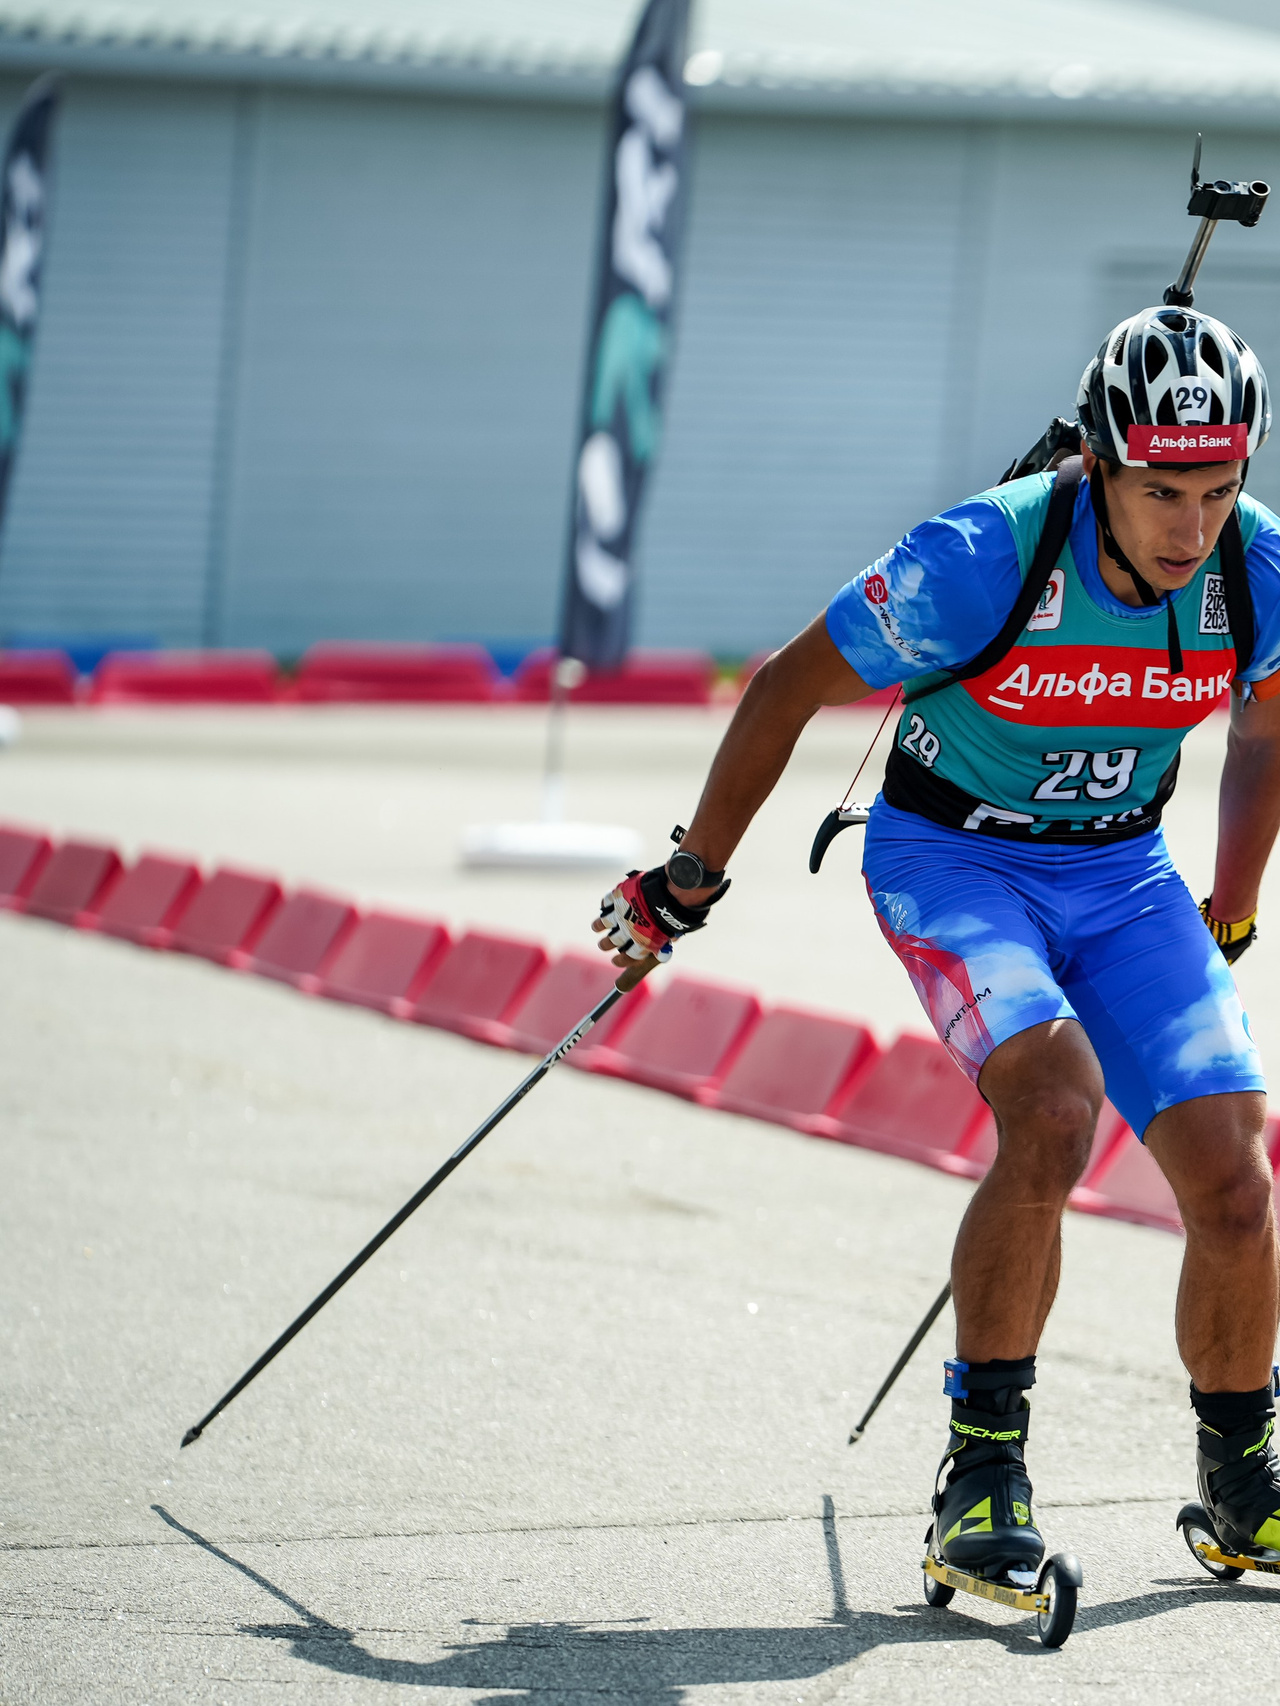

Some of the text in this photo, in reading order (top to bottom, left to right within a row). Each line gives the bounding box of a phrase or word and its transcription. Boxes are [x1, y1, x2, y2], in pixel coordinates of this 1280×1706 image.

[1175, 386, 1208, 412] 29
[1149, 434, 1232, 451] Альфа Банк
[1205, 593, 1225, 611] 202
[991, 663, 1232, 706] Альфа Банк
[901, 713, 941, 769] 29
[1031, 748, 1141, 801] 29
[950, 1419, 1021, 1441] FISCHER
